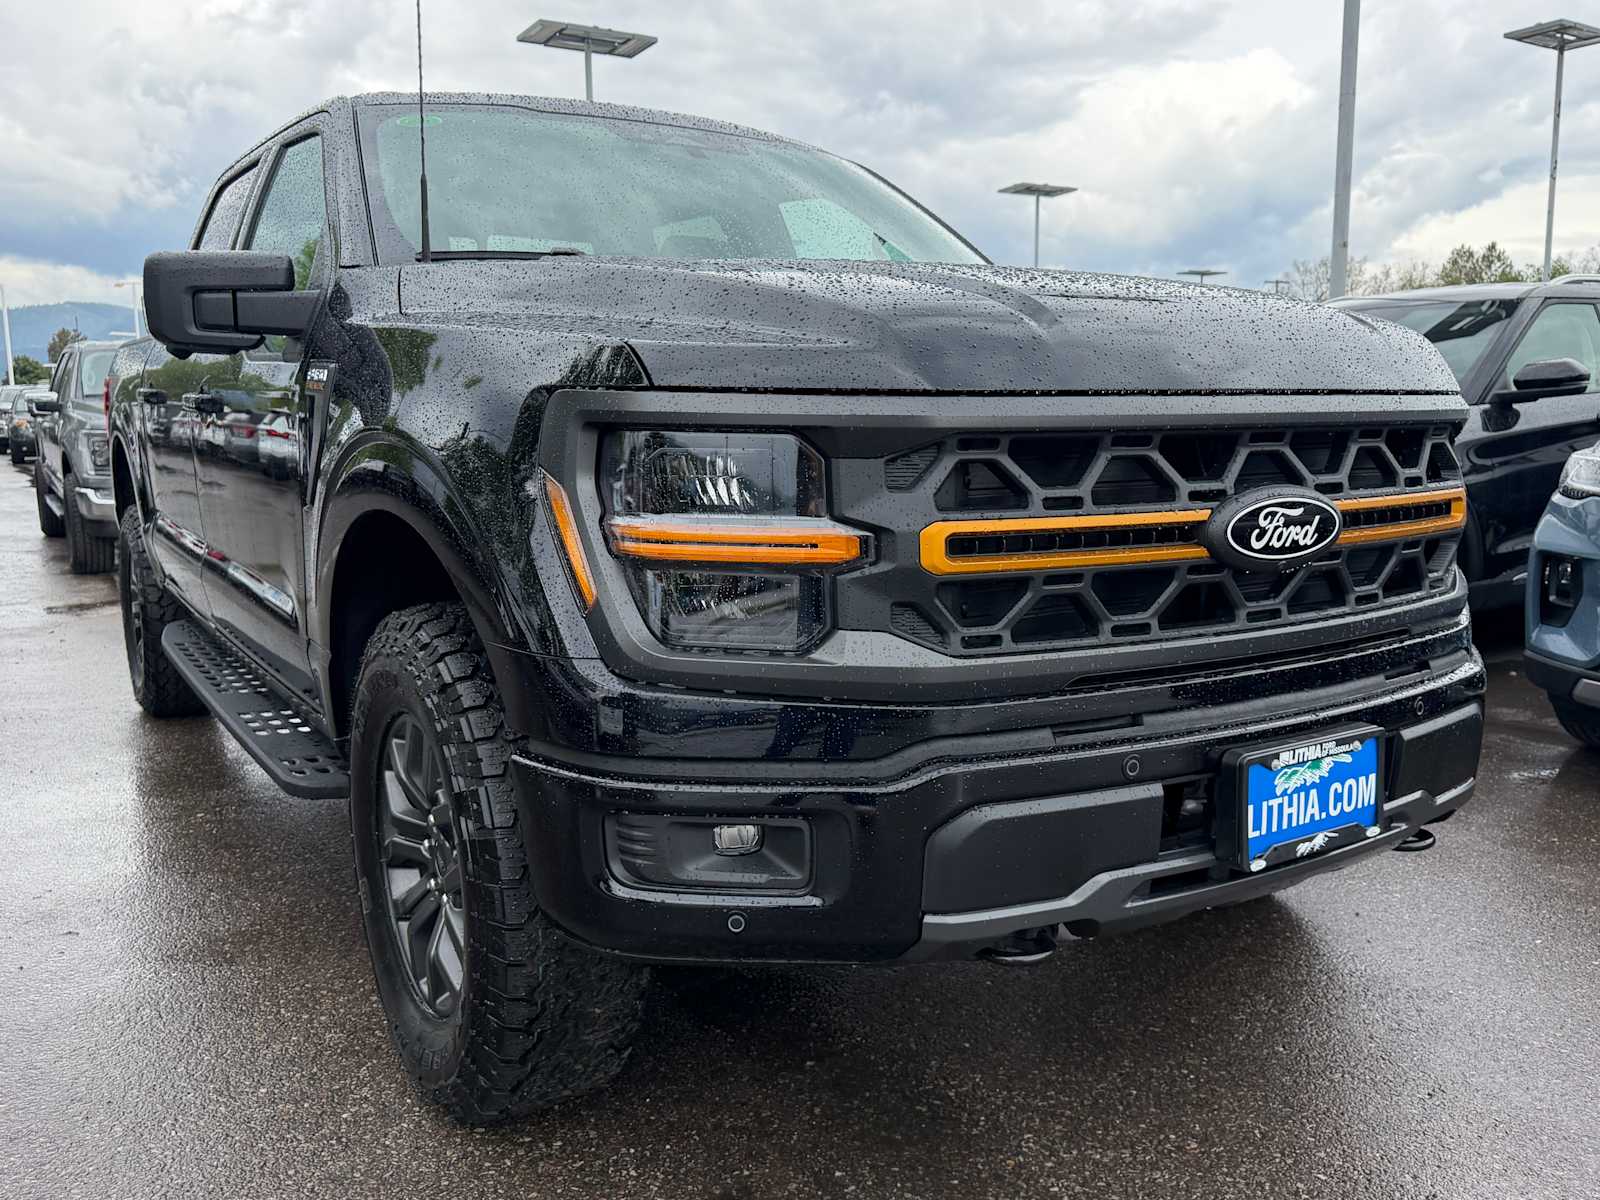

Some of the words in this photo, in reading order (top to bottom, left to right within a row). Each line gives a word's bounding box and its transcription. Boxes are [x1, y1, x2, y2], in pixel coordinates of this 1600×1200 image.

[1250, 507, 1321, 550] Ford
[1289, 745, 1322, 764] LITHIA
[1248, 773, 1376, 838] LITHIA.COM
